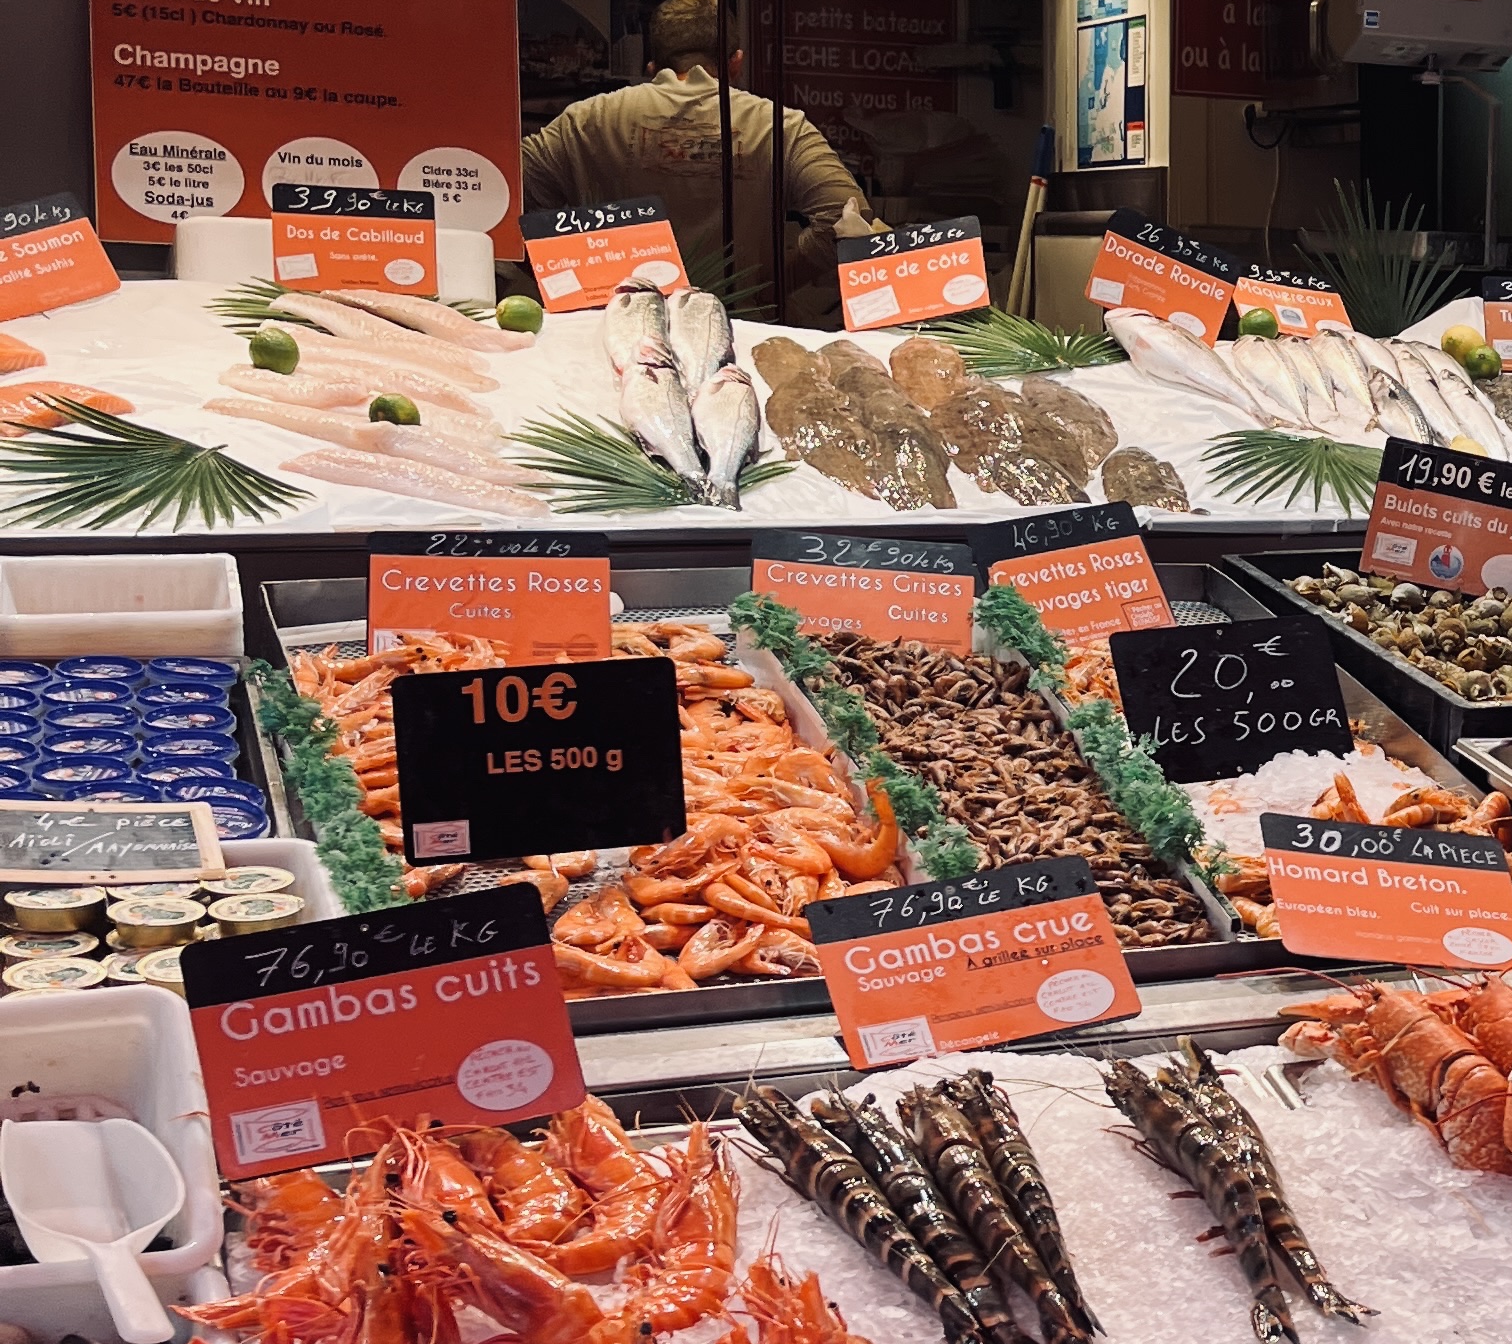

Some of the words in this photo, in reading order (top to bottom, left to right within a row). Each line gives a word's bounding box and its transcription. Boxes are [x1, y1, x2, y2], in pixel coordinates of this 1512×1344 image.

[114, 43, 280, 79] Champagne
[329, 155, 363, 168] mois
[144, 191, 214, 208] Soda-jus
[12, 230, 84, 258] Saumon
[286, 225, 314, 239] Dos
[320, 227, 340, 240] de
[347, 227, 424, 244] Cabillaud
[586, 236, 609, 249] Bar
[848, 266, 888, 287] Sole
[896, 260, 920, 278] de
[927, 252, 970, 271] côte
[1104, 235, 1165, 276] Dorade
[1169, 263, 1225, 302] Royale
[1237, 278, 1333, 308] Maquereaux
[1399, 453, 1473, 490] 19,90
[1384, 493, 1438, 521] Bulots
[1442, 509, 1482, 531] cuits
[1486, 516, 1509, 535] du
[1089, 550, 1144, 573] Roses
[381, 568, 517, 592] Crevettes
[528, 571, 602, 594] Roses
[767, 563, 884, 591] Crevettes
[893, 574, 962, 597] Grises
[1105, 578, 1148, 599] tiger
[450, 602, 512, 618] Cuites
[888, 605, 949, 624] Cuites
[461, 671, 578, 725] 10€
[1153, 715, 1208, 747] LES
[487, 750, 543, 775] LES
[550, 746, 599, 771] 500
[607, 747, 624, 772] g
[1268, 856, 1368, 886] Homard
[1378, 869, 1468, 896] Breton.
[1276, 897, 1342, 916] Européen
[1347, 906, 1382, 920] bleu.
[1410, 901, 1439, 915] Cuit
[1445, 906, 1463, 918] sur
[1468, 908, 1512, 922] place.
[844, 930, 1001, 976] Gambas
[1013, 912, 1094, 943] crue
[1060, 934, 1104, 952] place
[858, 964, 947, 993] Sauvage
[220, 983, 418, 1043] Gambas
[435, 958, 541, 1003] cuits
[233, 1053, 348, 1088] Sauvage
